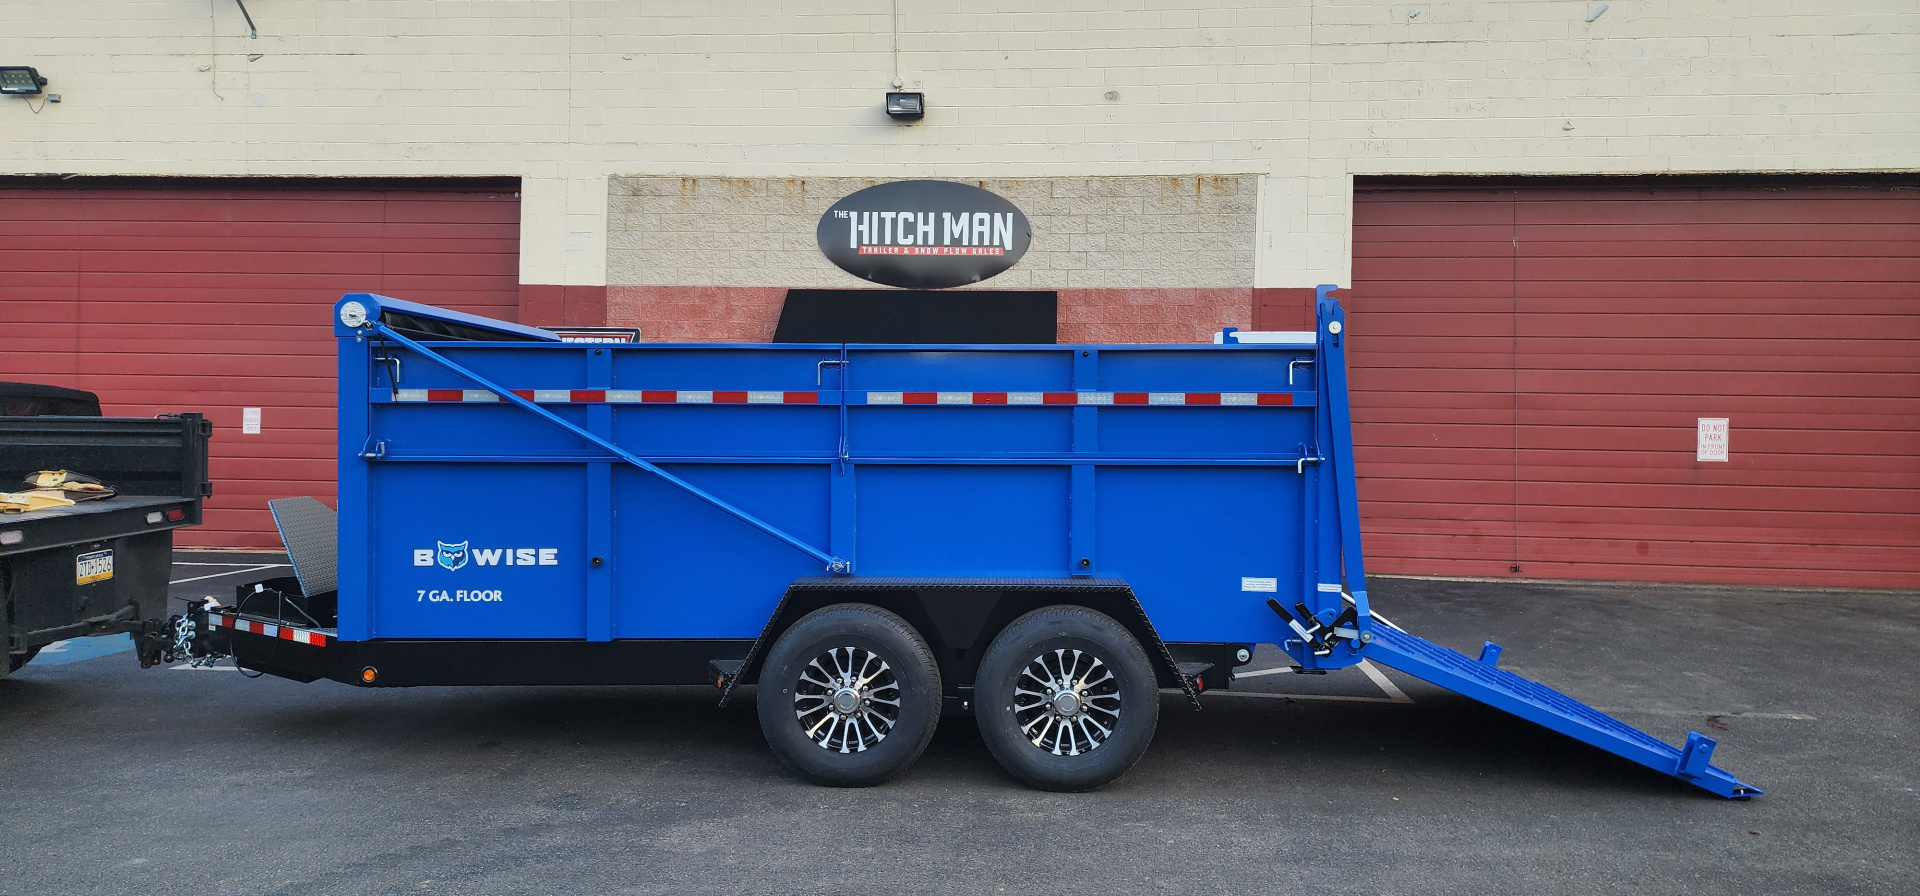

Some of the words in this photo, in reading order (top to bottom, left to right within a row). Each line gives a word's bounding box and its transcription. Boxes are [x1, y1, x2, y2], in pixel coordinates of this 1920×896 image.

[834, 210, 849, 219] THE
[849, 211, 935, 249] HITCH
[942, 212, 1014, 250] MAN
[862, 246, 899, 254] TRAILER
[914, 247, 939, 255] SNOW
[943, 247, 967, 255] PLOW
[972, 247, 1001, 255] SALES
[1701, 424, 1711, 432] DO
[1713, 424, 1726, 432] NOT
[1704, 433, 1722, 442] PARK
[416, 590, 426, 602] 7
[428, 590, 454, 602] GA.
[456, 590, 503, 602] FLOOR
